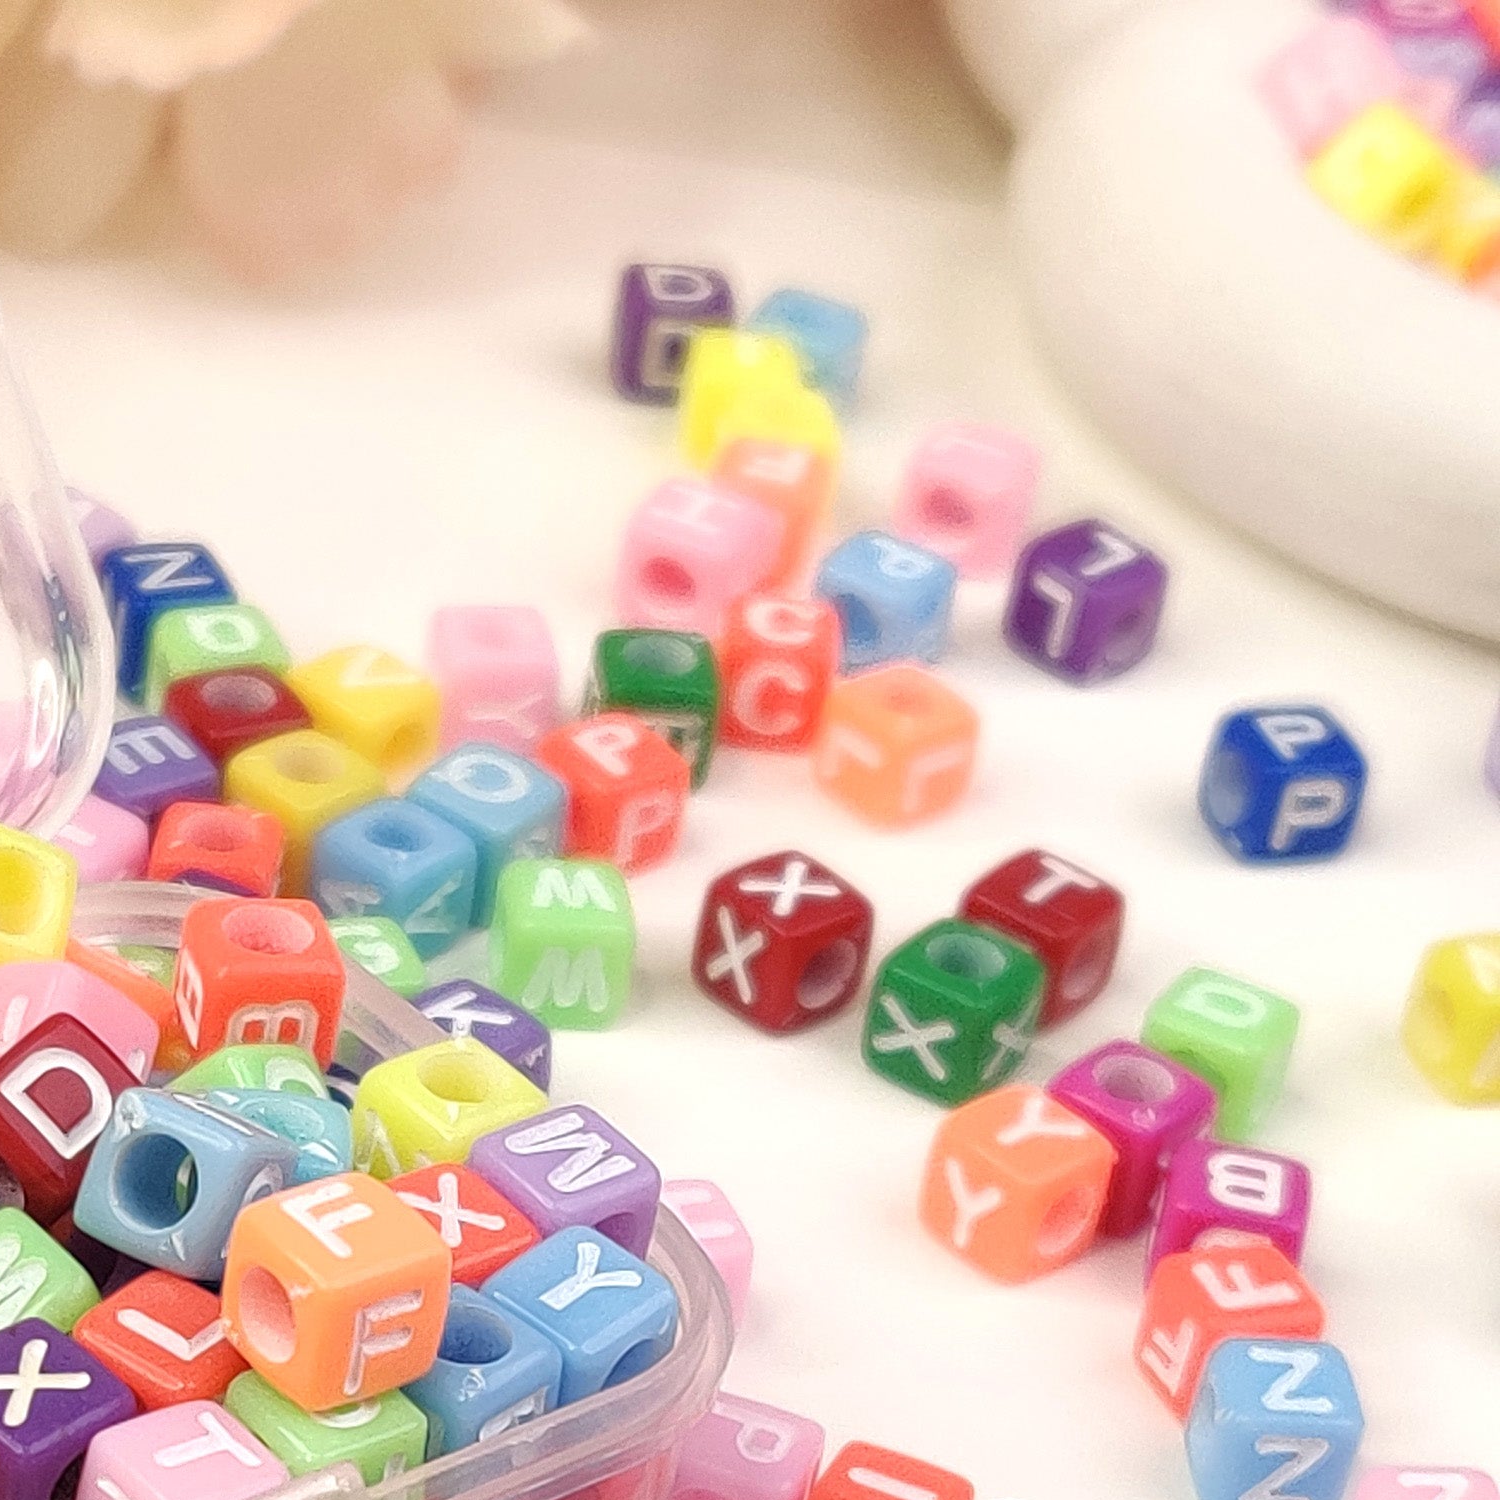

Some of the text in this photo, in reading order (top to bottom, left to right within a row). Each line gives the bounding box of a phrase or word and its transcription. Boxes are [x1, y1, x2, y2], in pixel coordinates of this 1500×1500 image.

[744, 601, 820, 644] C
[737, 661, 806, 735] C
[106, 725, 197, 775] E
[573, 723, 641, 776] P
[1255, 713, 1329, 760] P
[616, 789, 678, 872] P
[1271, 779, 1347, 850] P
[738, 860, 841, 915] X
[1023, 854, 1100, 904] T
[707, 906, 763, 1005] X
[427, 990, 513, 1037] K
[871, 994, 955, 1081] X
[0, 1046, 113, 1160] D
[996, 1097, 1085, 1146] Y
[396, 1172, 506, 1248] X
[944, 1158, 1002, 1250] Y
[1206, 1152, 1287, 1217] B
[279, 1181, 375, 1259] F
[538, 1241, 643, 1312] Y
[1191, 1260, 1300, 1310] F
[116, 1309, 230, 1361] L
[342, 1289, 423, 1397] F
[1247, 1345, 1334, 1414] Z
[153, 1410, 262, 1469] T
[711, 1400, 795, 1465] P
